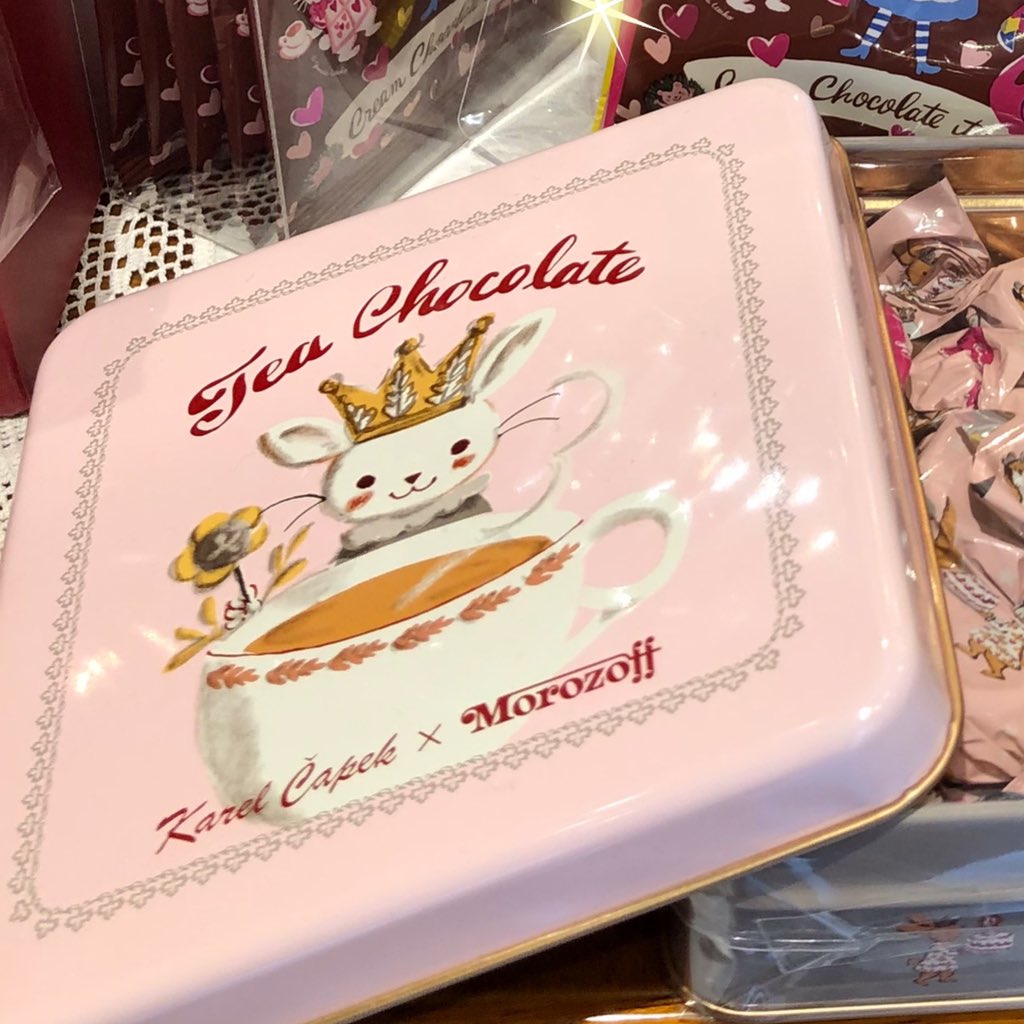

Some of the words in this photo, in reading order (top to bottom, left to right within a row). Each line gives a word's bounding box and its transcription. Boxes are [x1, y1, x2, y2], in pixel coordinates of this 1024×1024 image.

[348, 76, 407, 140] Cream
[809, 74, 950, 130] Chocolate
[188, 334, 334, 437] Tea
[352, 233, 646, 340] Chocolate
[155, 782, 269, 856] Karel
[459, 635, 662, 735] Morozoff
